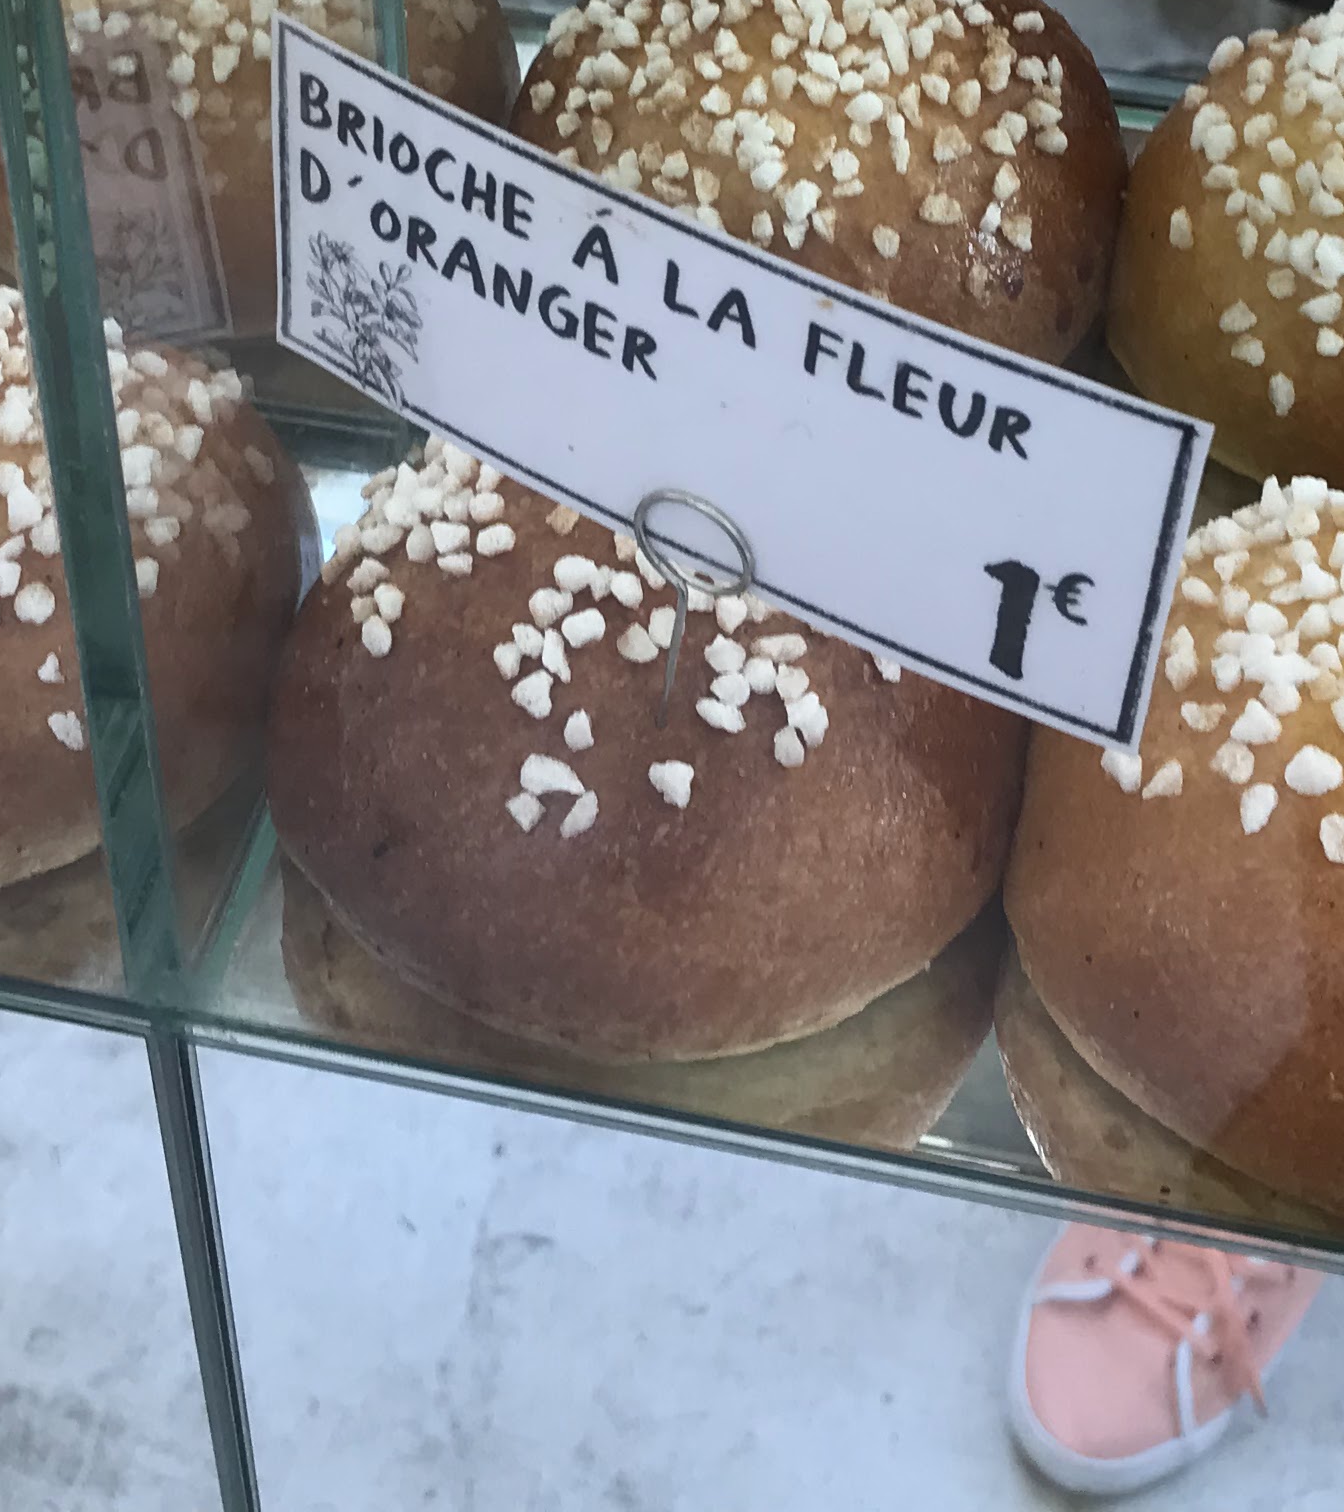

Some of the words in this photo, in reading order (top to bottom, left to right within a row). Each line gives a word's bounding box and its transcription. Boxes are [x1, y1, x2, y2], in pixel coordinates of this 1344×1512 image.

[299, 71, 535, 241] BRIOCHE
[662, 258, 757, 350] LA
[802, 320, 1032, 461] FLEUR
